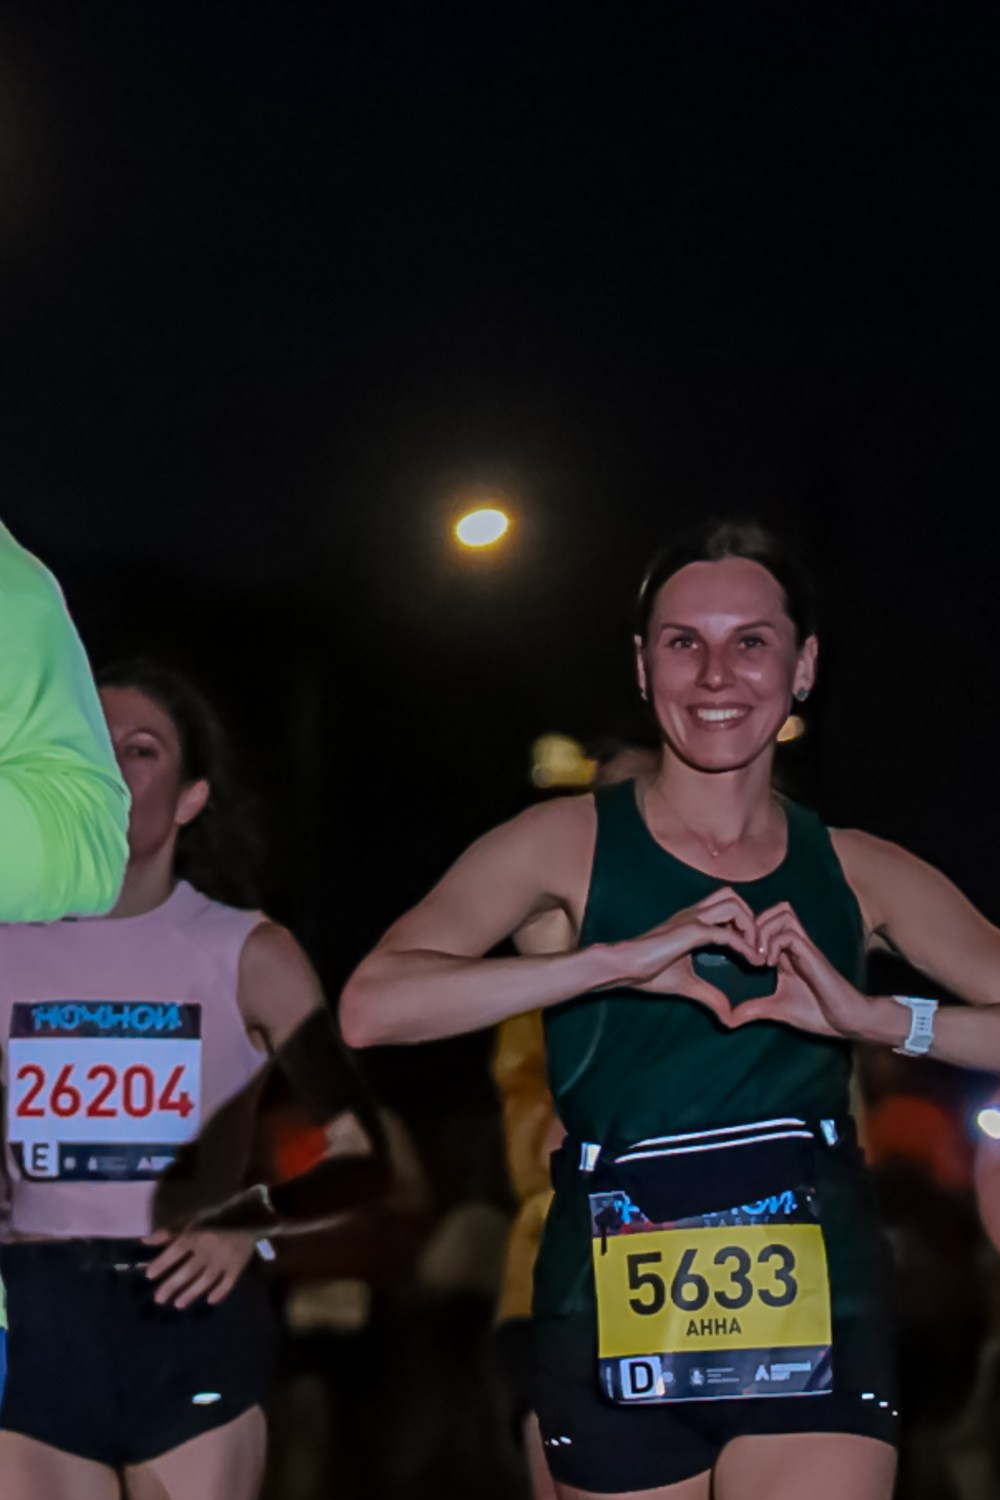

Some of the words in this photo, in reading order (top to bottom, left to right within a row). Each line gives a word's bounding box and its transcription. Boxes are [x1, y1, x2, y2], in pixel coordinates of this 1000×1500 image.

[15, 1063, 195, 1118] 26204
[32, 1143, 49, 1171] E
[626, 1243, 798, 1316] 5633
[686, 1318, 742, 1337] АННА
[629, 1361, 655, 1395] D
